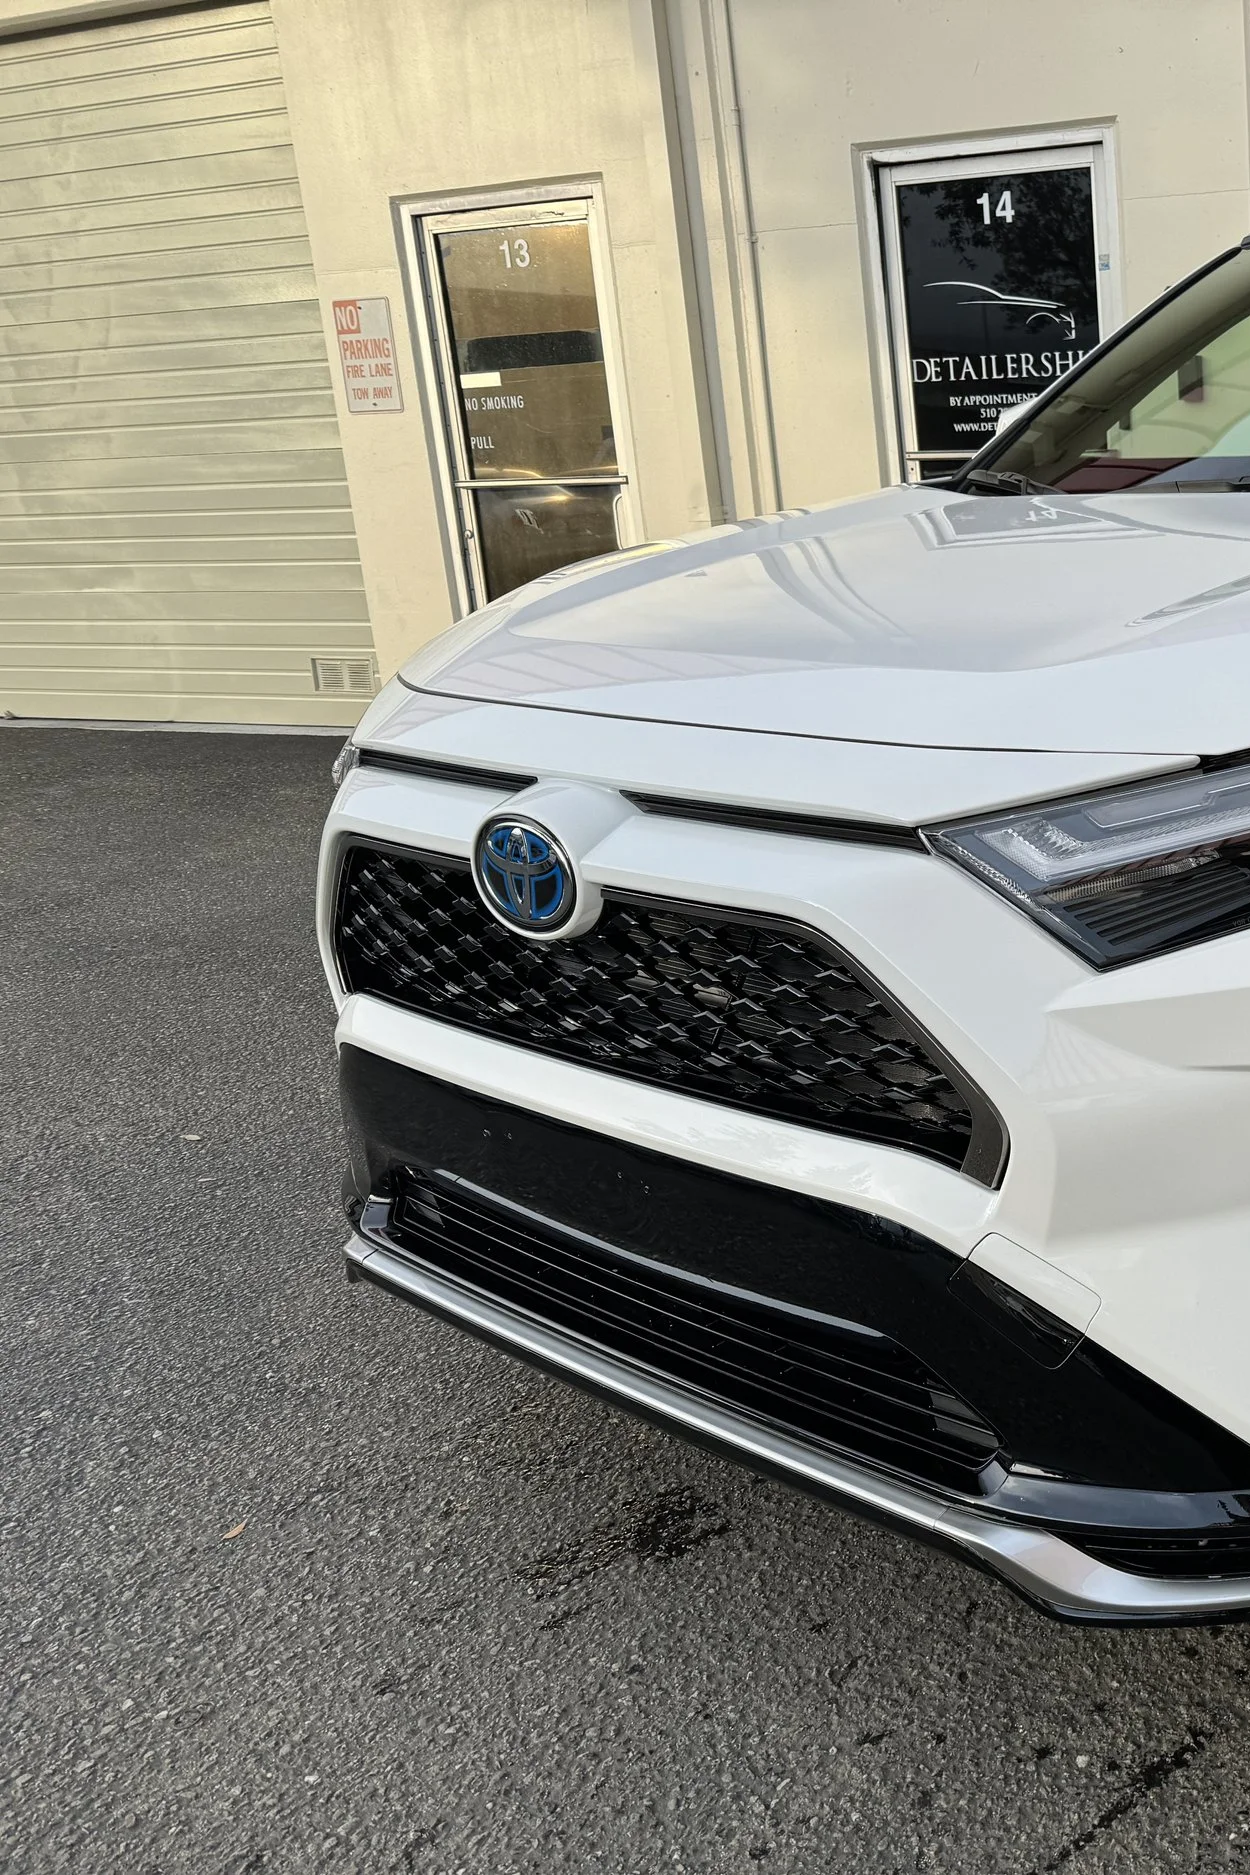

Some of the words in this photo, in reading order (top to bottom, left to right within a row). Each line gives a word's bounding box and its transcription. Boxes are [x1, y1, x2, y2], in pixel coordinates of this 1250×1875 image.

[976, 190, 1015, 225] 14
[499, 239, 531, 269] 13
[335, 305, 358, 331] NO
[342, 338, 391, 361] PARKING
[346, 364, 366, 379] FIRE
[368, 363, 393, 378] LANE
[352, 387, 369, 401] TOW
[372, 386, 393, 399] AWAY
[949, 396, 962, 407] BY
[465, 397, 479, 411] NO
[481, 395, 525, 411] SMOKING
[980, 407, 997, 418] 510
[470, 436, 495, 450] PULL
